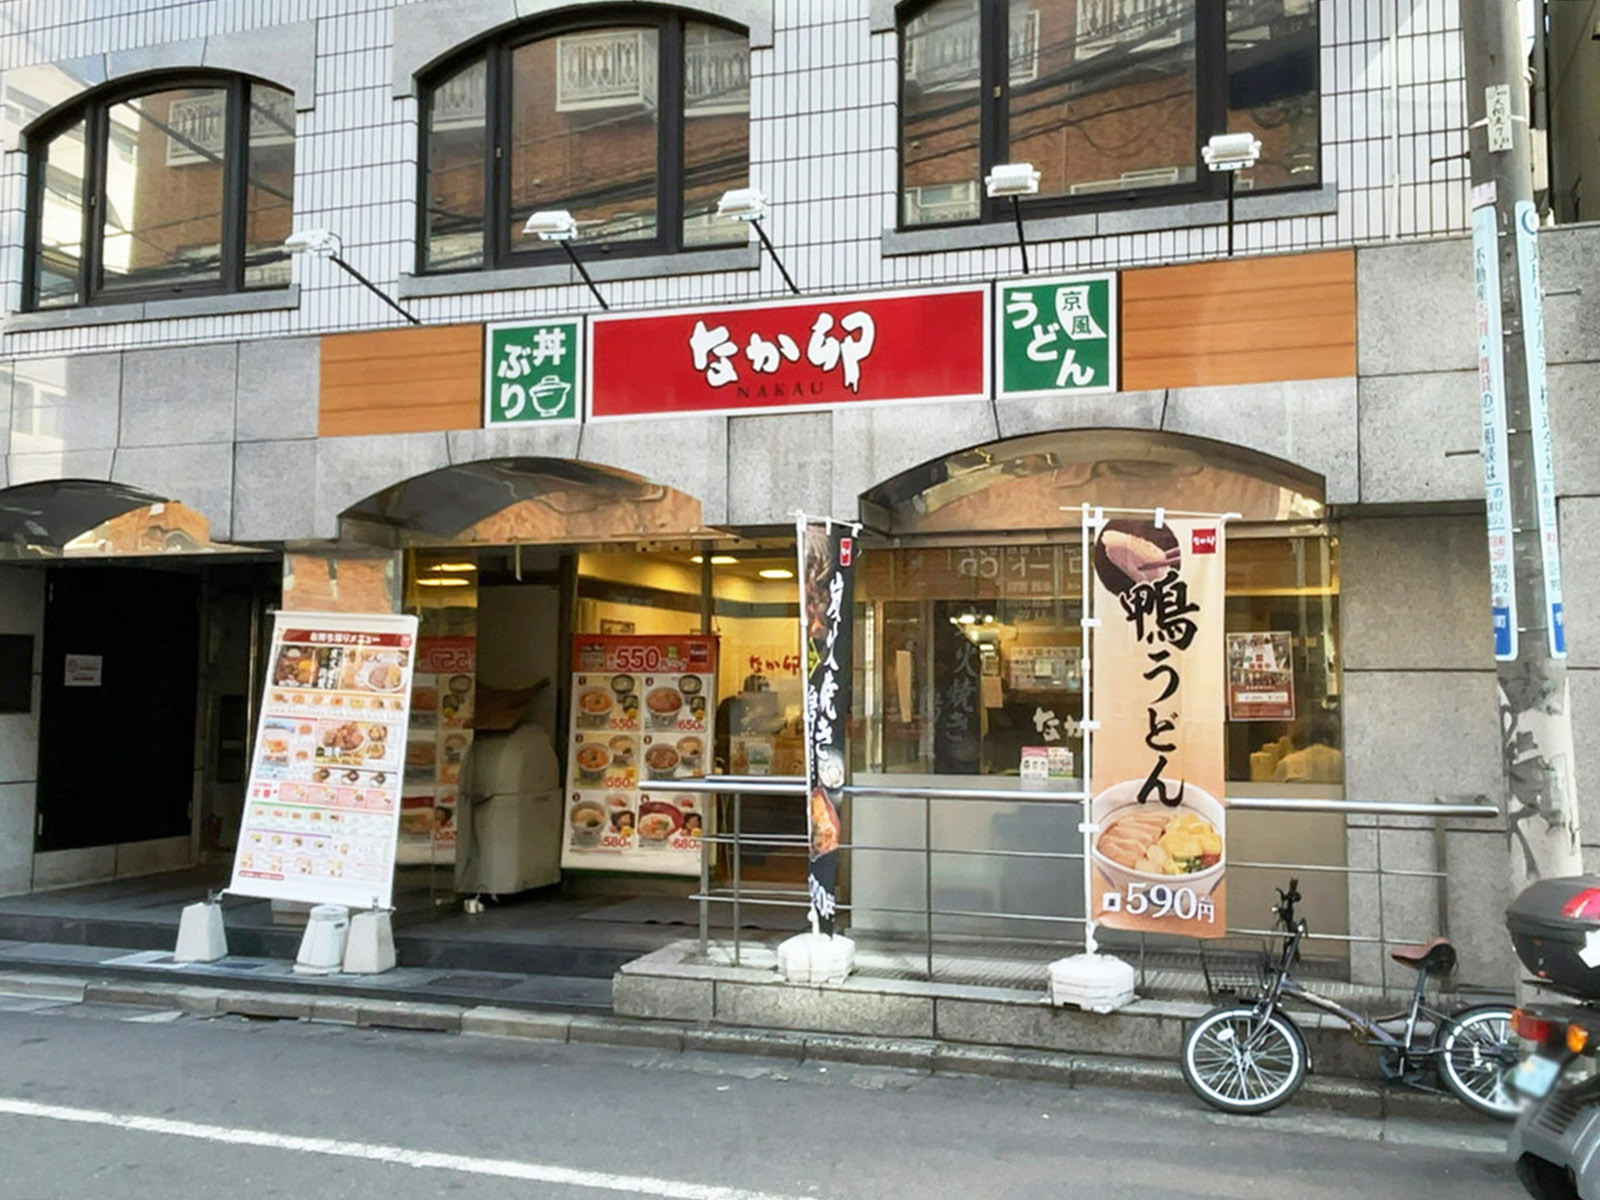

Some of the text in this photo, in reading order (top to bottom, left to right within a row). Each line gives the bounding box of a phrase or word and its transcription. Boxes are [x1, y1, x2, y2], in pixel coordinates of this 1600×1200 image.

[689, 311, 875, 395] なか卯
[1006, 292, 1095, 387] うどん
[1061, 291, 1092, 335] 京風
[497, 327, 567, 419] 丼ぶり
[737, 382, 824, 398] NAKAU
[1119, 572, 1200, 807] 鴨うどん
[1125, 882, 1214, 923] 590円
